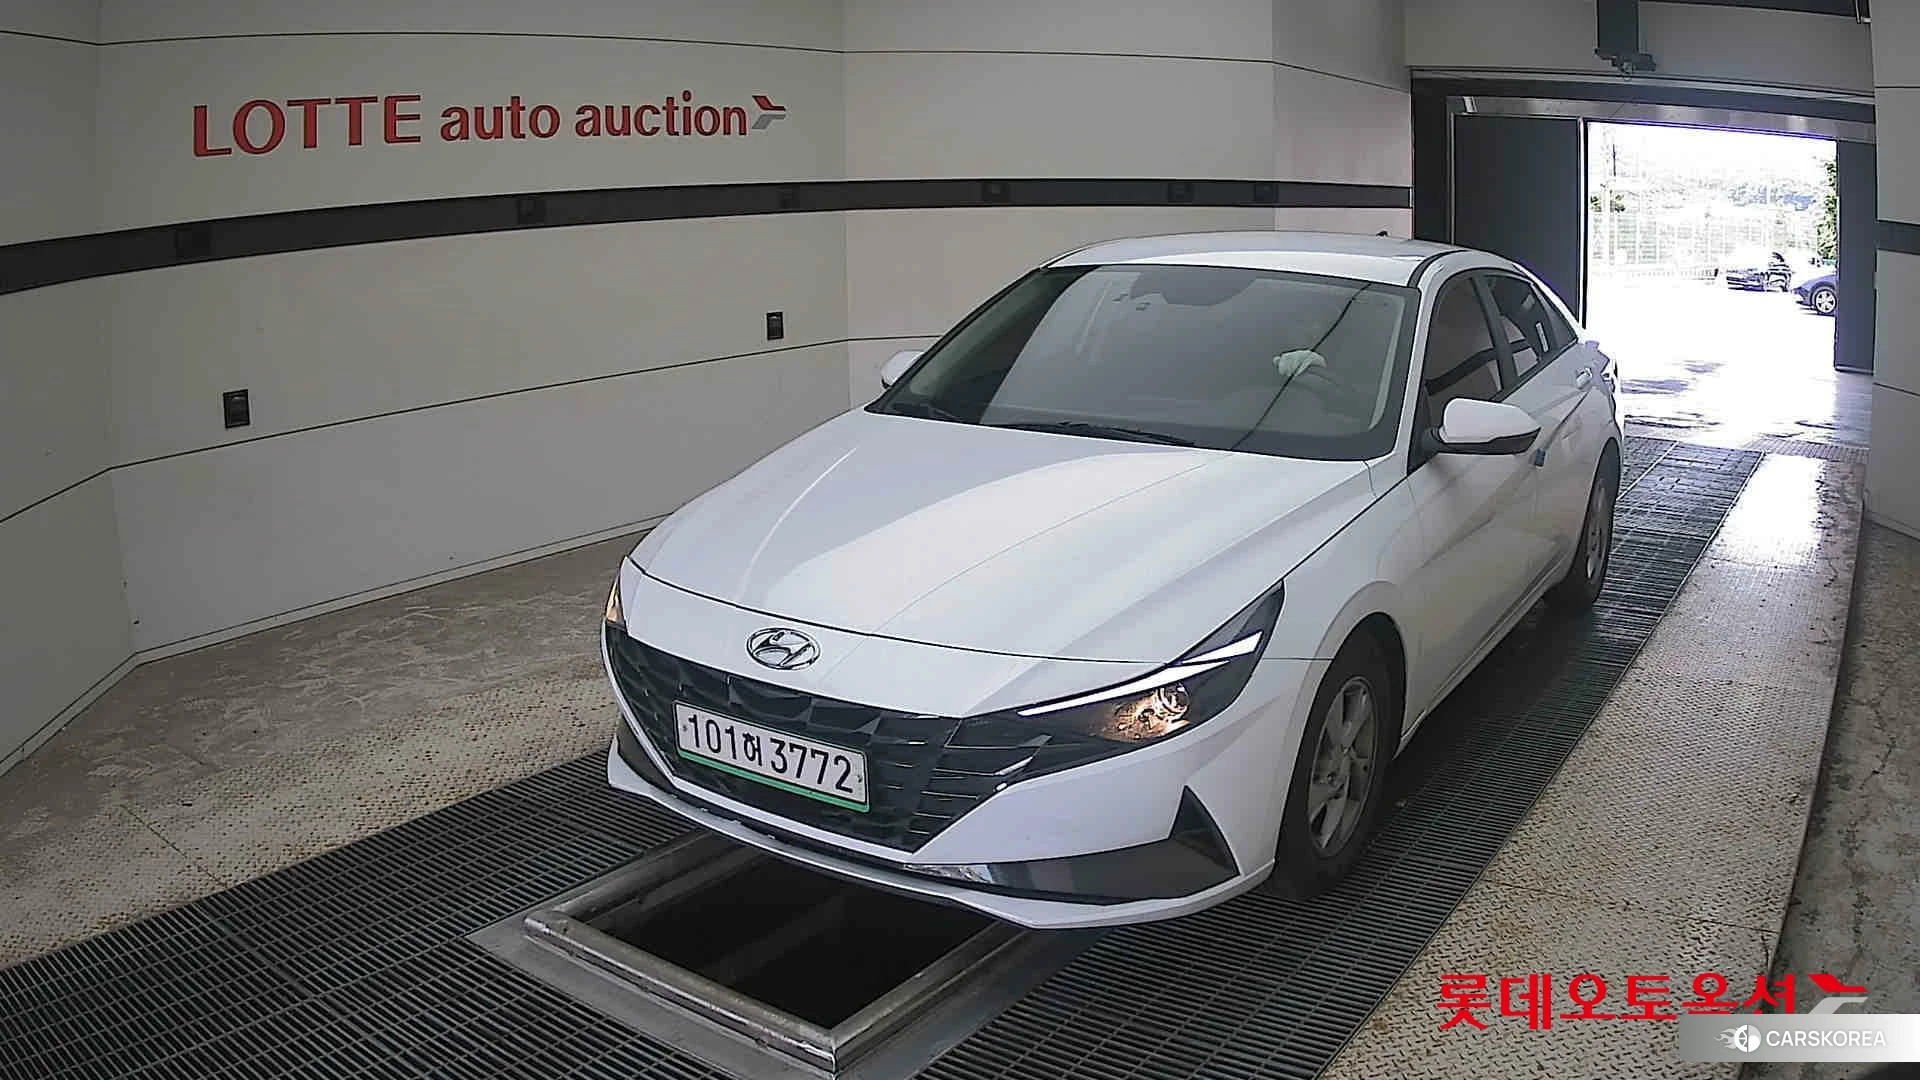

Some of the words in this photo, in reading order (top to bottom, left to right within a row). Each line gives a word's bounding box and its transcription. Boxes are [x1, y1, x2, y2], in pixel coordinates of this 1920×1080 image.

[193, 95, 422, 157] LOTTE
[440, 96, 560, 141] auto
[575, 90, 748, 137] auction
